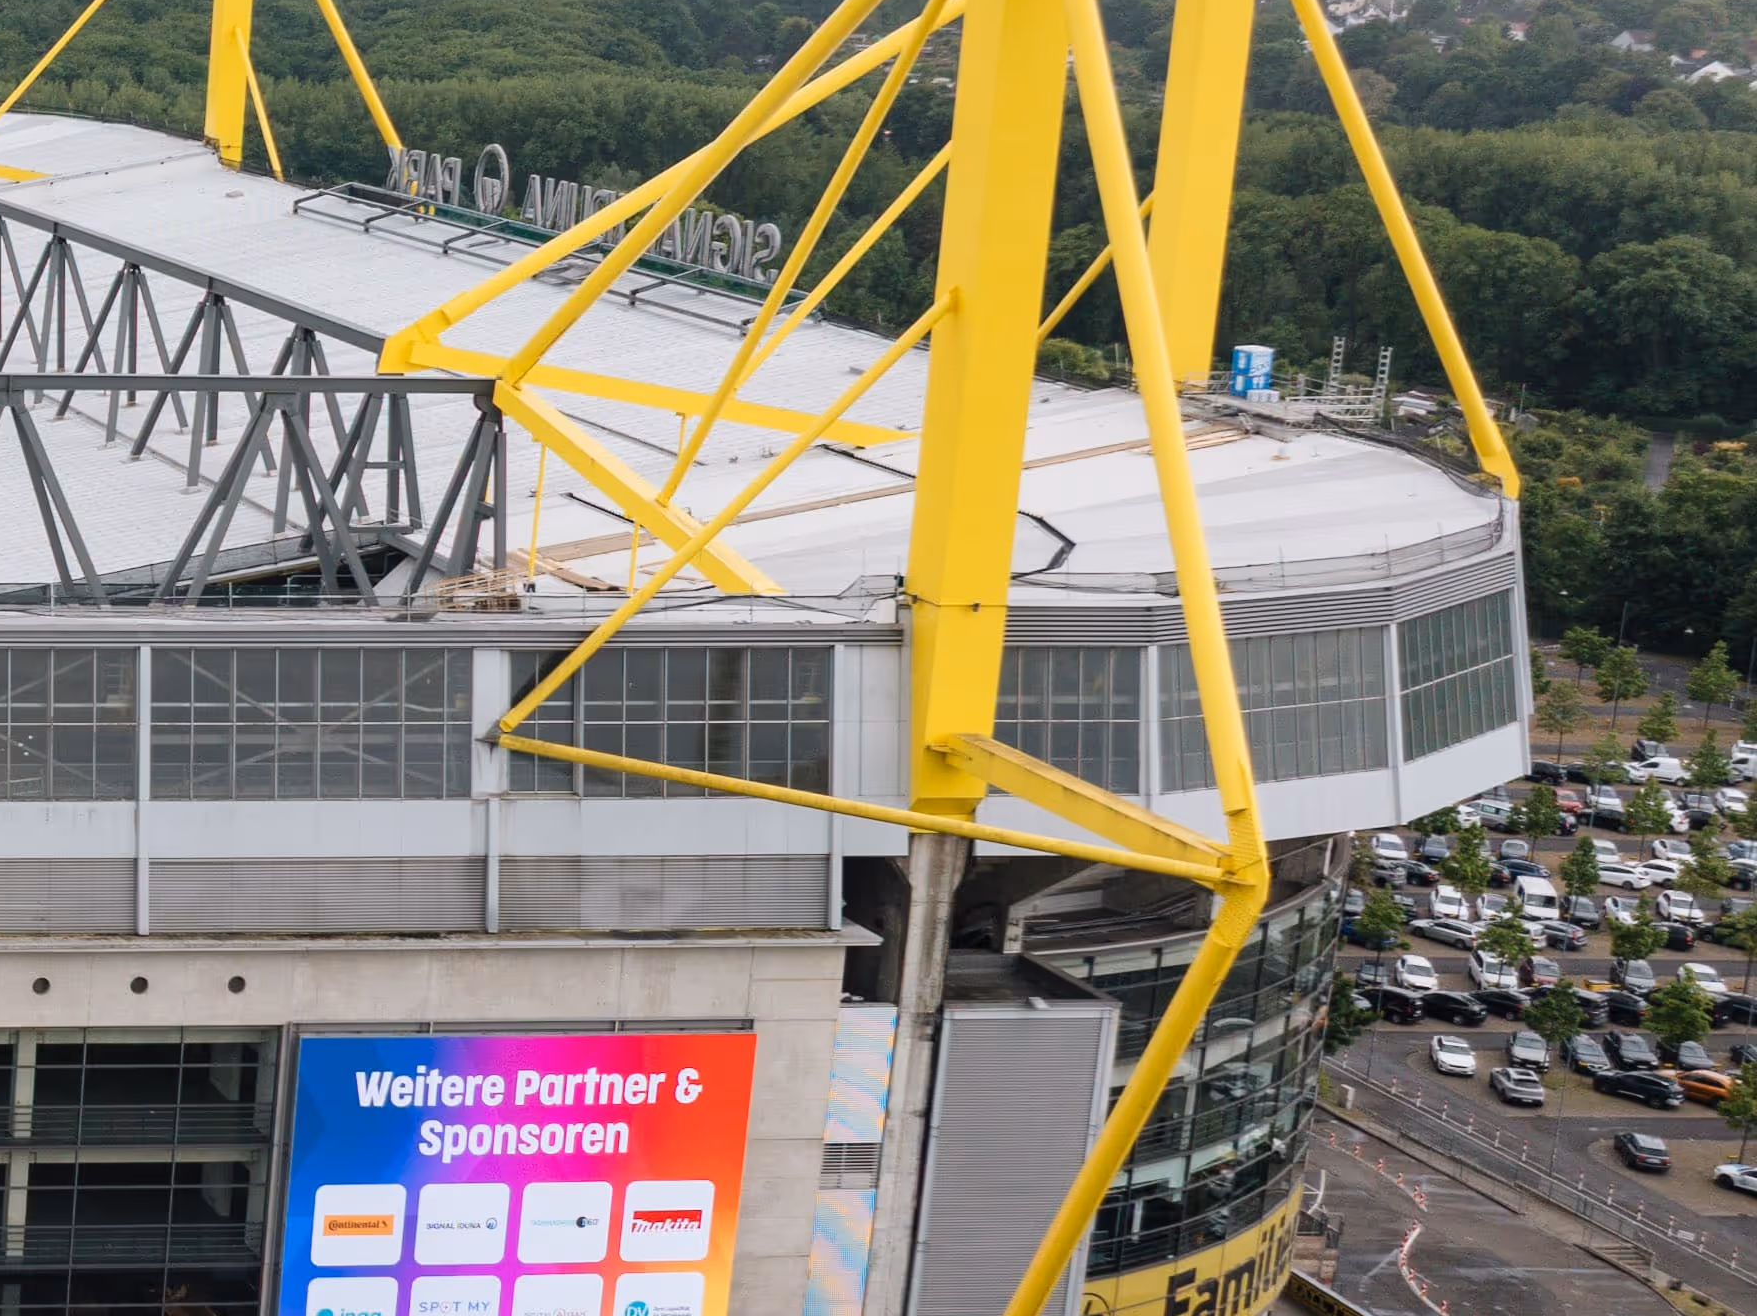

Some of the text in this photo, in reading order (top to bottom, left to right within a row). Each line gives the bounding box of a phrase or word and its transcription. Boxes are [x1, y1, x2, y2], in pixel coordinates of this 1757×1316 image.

[356, 1066, 702, 1108] Weitere Partner &
[419, 1120, 628, 1163] Sponsoren
[328, 1219, 380, 1231] Continental
[631, 1219, 701, 1234] makita
[419, 1301, 490, 1313] SPOT MY
